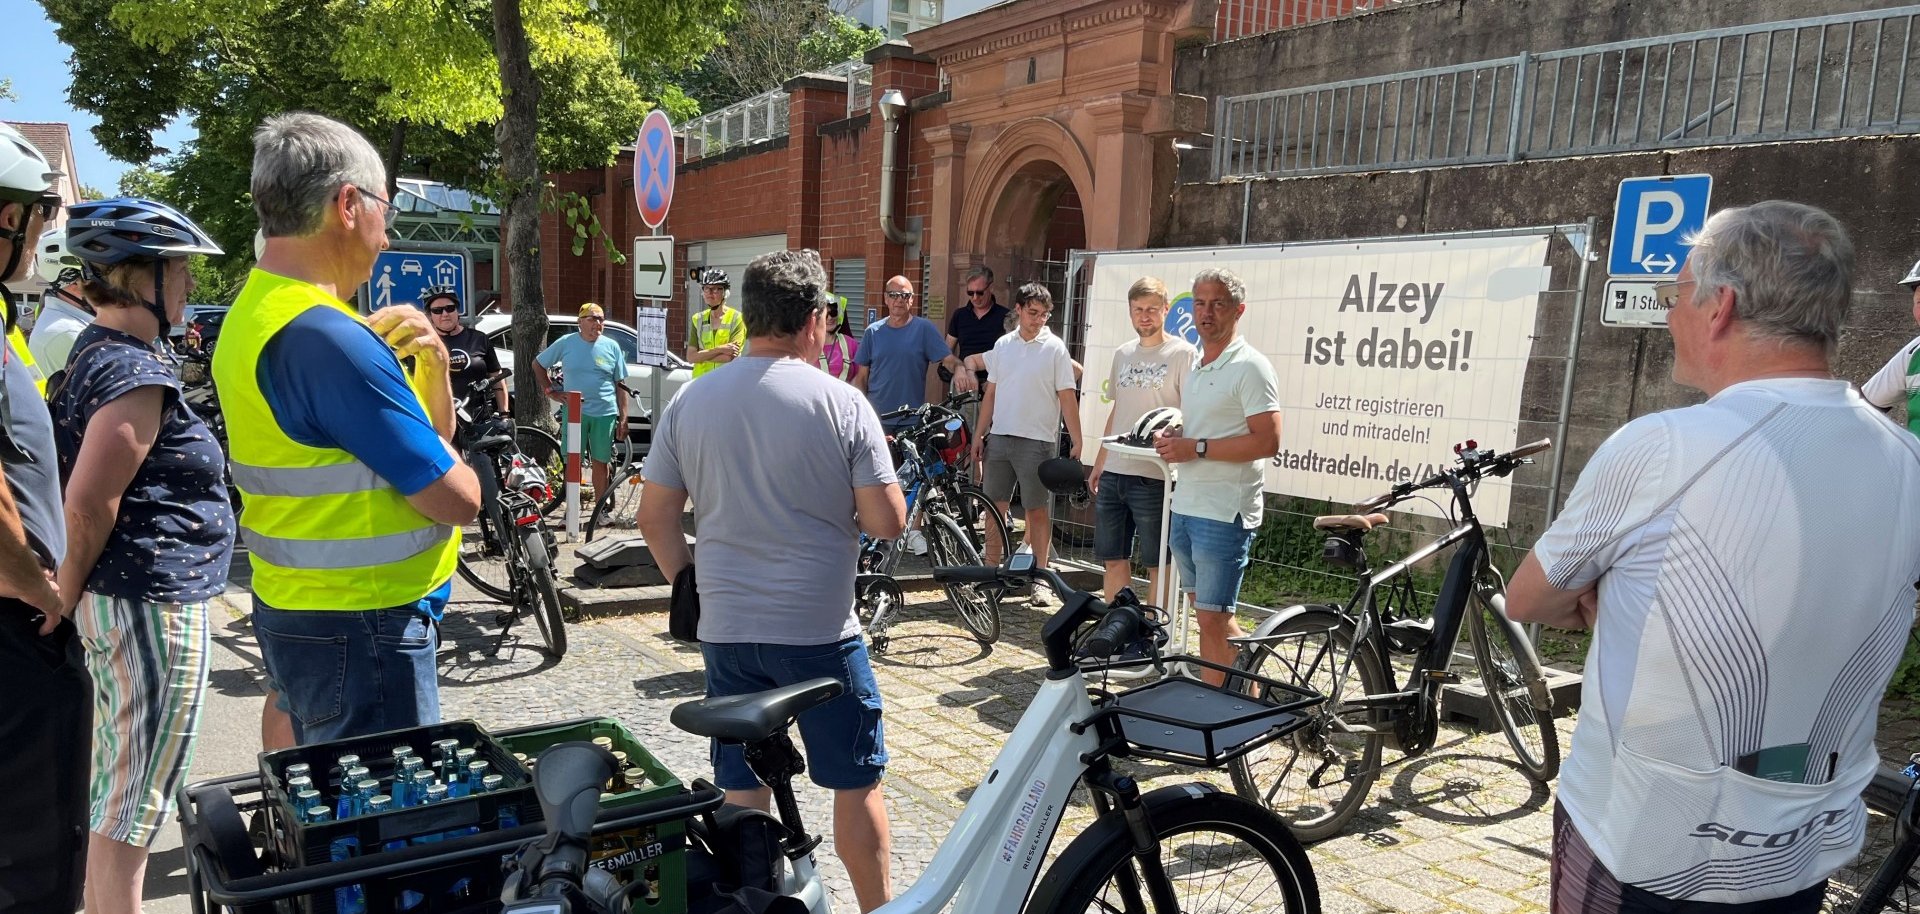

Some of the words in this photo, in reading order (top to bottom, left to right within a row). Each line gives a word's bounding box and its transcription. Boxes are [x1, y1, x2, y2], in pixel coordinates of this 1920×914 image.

[90, 219, 116, 228] uvex
[1630, 190, 1684, 264] P
[1338, 271, 1445, 324] Alzey
[1631, 295, 1637, 309] 1
[1303, 326, 1348, 366] ist
[1355, 326, 1473, 372] dabei!
[1315, 391, 1352, 411] Jetzt
[1355, 397, 1445, 418] registrieren
[1321, 419, 1348, 436] und
[1351, 421, 1431, 445] mitradeln!
[1002, 778, 1046, 864] #FAHRRADLAND
[1689, 808, 1847, 849] SCOTT
